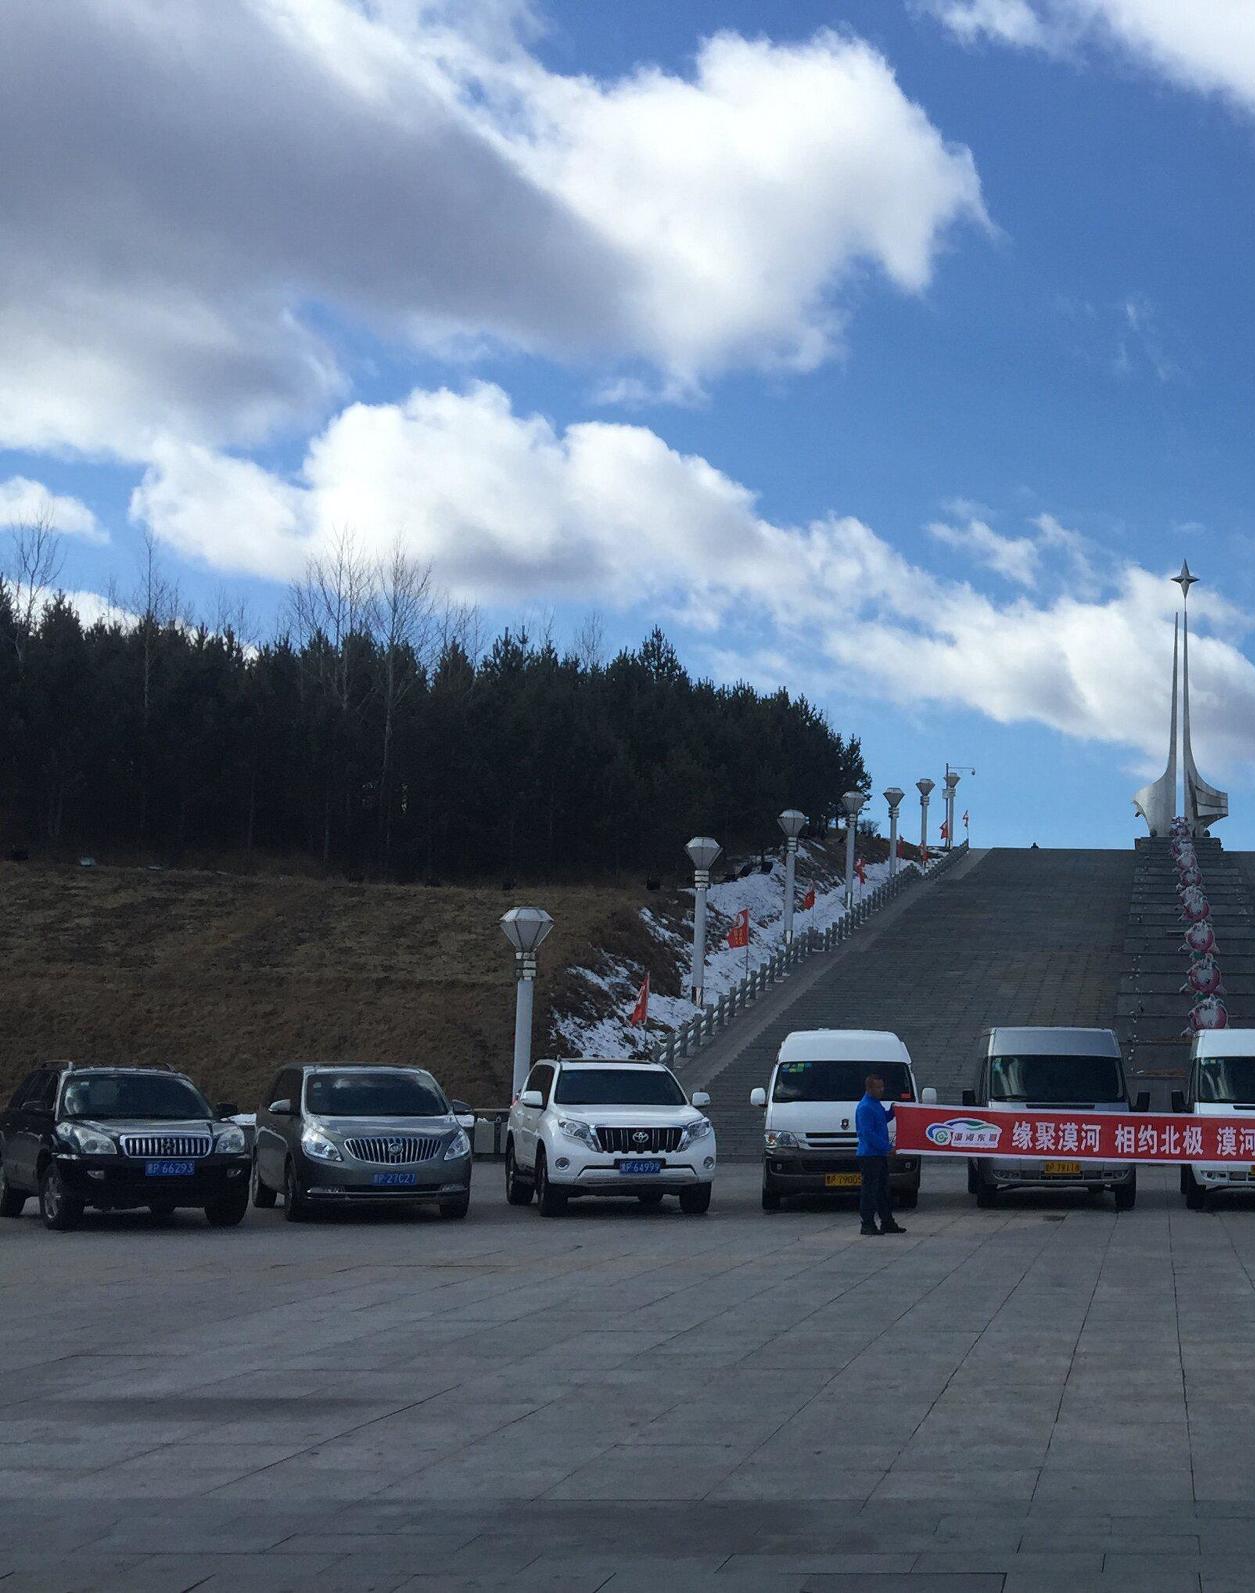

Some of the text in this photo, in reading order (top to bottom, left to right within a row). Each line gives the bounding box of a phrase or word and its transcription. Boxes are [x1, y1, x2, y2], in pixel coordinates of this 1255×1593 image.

[1011, 1120, 1102, 1152] 缘聚漠河
[1114, 1122, 1204, 1155] 相约北极
